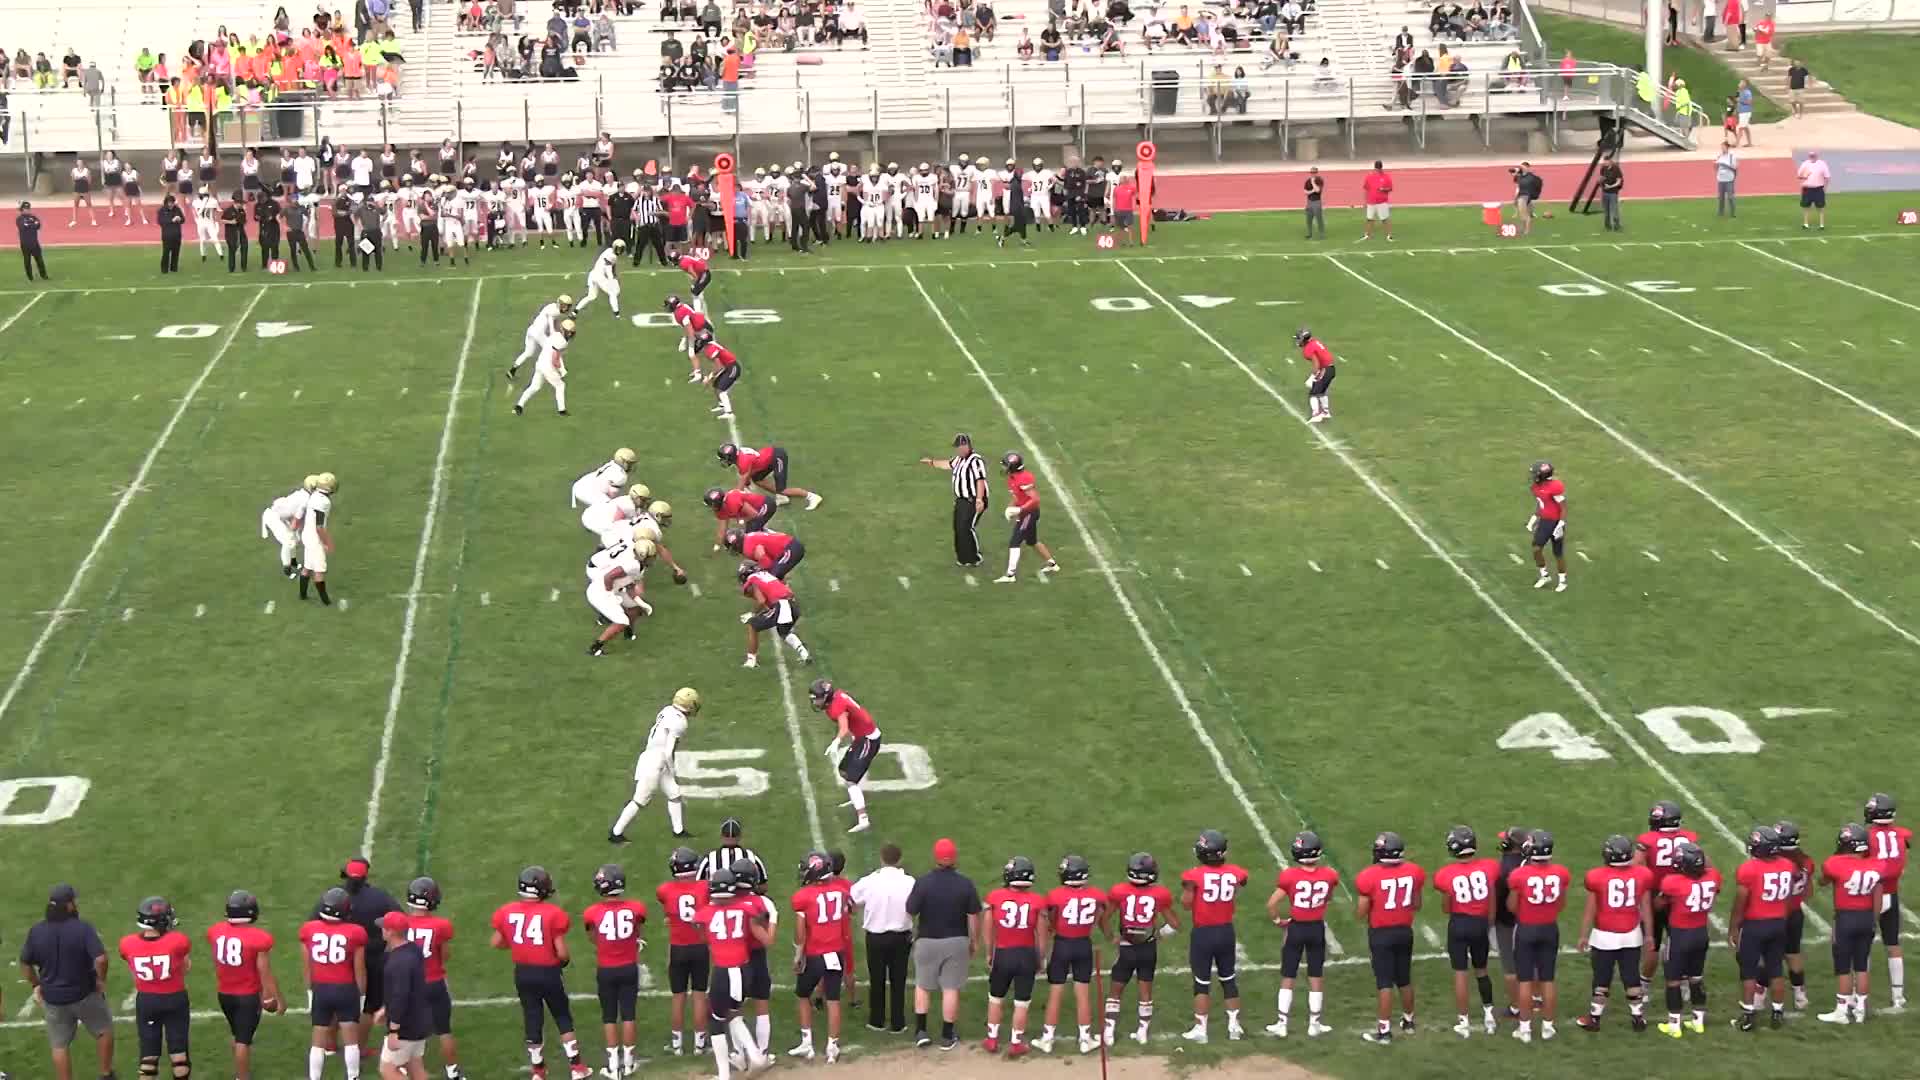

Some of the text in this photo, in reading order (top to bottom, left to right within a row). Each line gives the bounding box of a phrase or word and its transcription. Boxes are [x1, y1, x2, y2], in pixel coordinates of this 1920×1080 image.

[1500, 224, 1517, 237] 30
[1875, 830, 1900, 859] 11
[1203, 872, 1236, 902] 56
[1293, 880, 1330, 909] 22
[1380, 875, 1414, 910] 77
[1452, 870, 1489, 904] 88
[1527, 874, 1561, 904] 33
[1607, 878, 1637, 908] 61
[1685, 880, 1717, 913] 45
[1761, 871, 1792, 901] 58
[1844, 870, 1881, 895] 40
[816, 891, 843, 924] 17
[1000, 901, 1030, 929] 31
[1062, 897, 1097, 926] 42
[1124, 894, 1156, 923] 13
[508, 913, 544, 945] 74
[599, 909, 634, 942] 46
[709, 909, 744, 940] 47
[215, 935, 242, 967] 18
[311, 932, 348, 965] 26
[133, 954, 170, 981] 57
